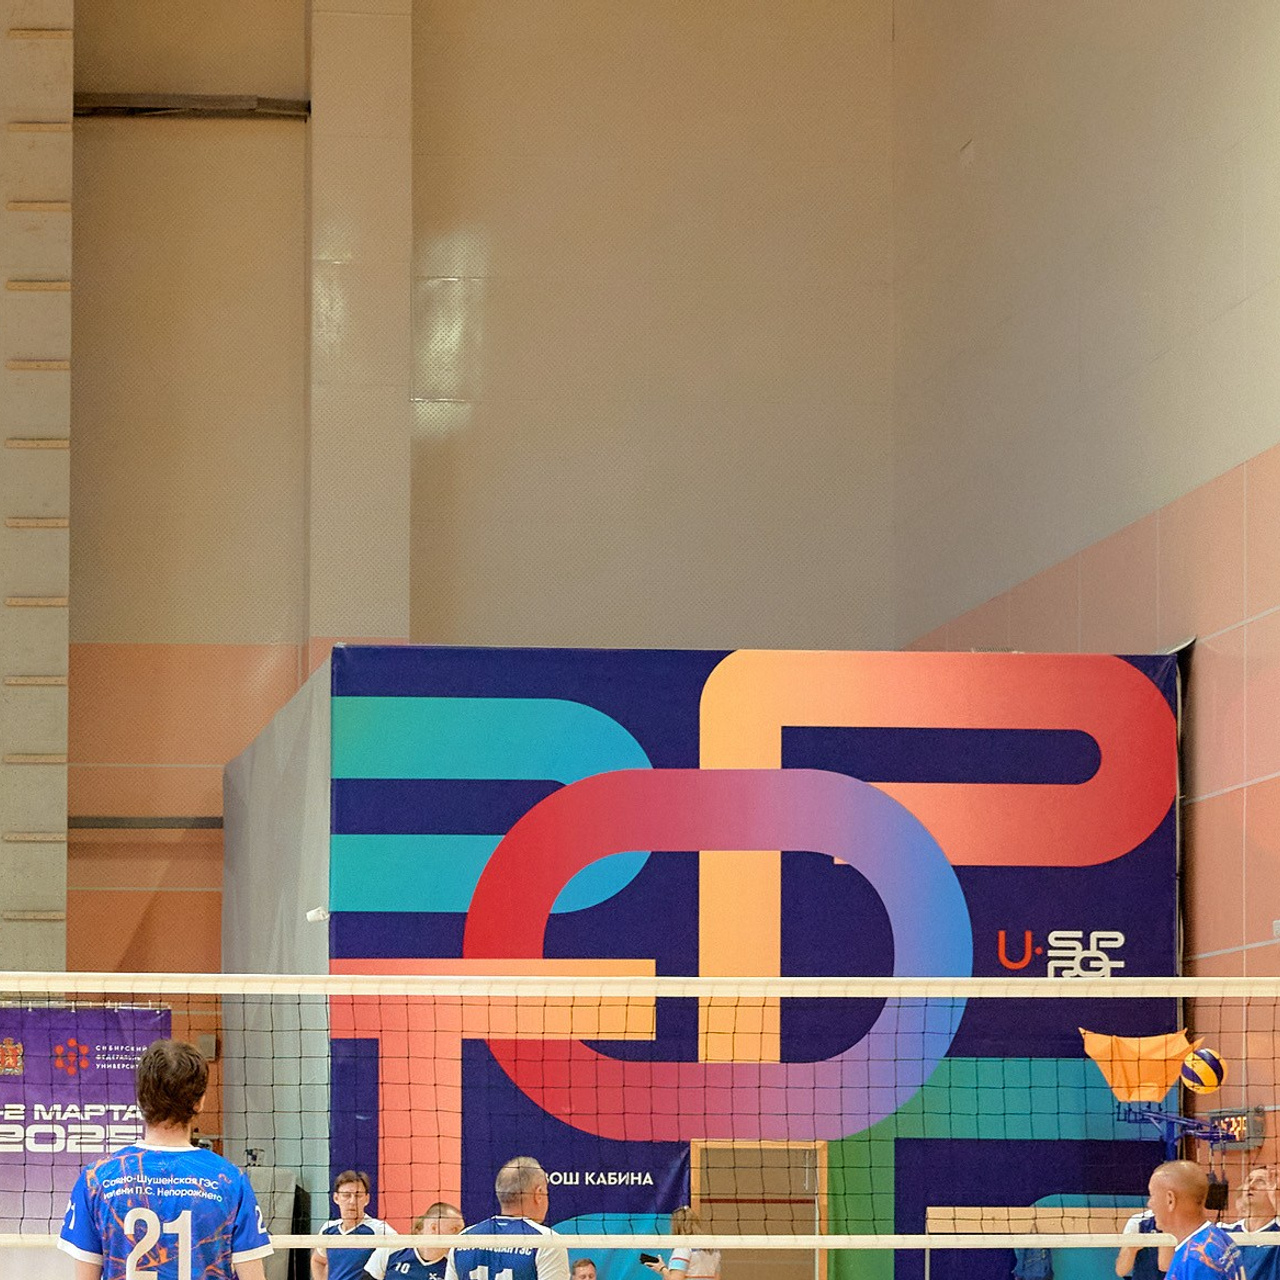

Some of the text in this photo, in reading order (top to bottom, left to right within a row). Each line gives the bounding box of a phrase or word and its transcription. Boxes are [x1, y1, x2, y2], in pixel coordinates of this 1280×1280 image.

[33, 1104, 144, 1121] МАРТА
[199, 1178, 219, 1190] ГЭС
[585, 1172, 654, 1186] КАБИНА
[395, 1262, 411, 1274] 10
